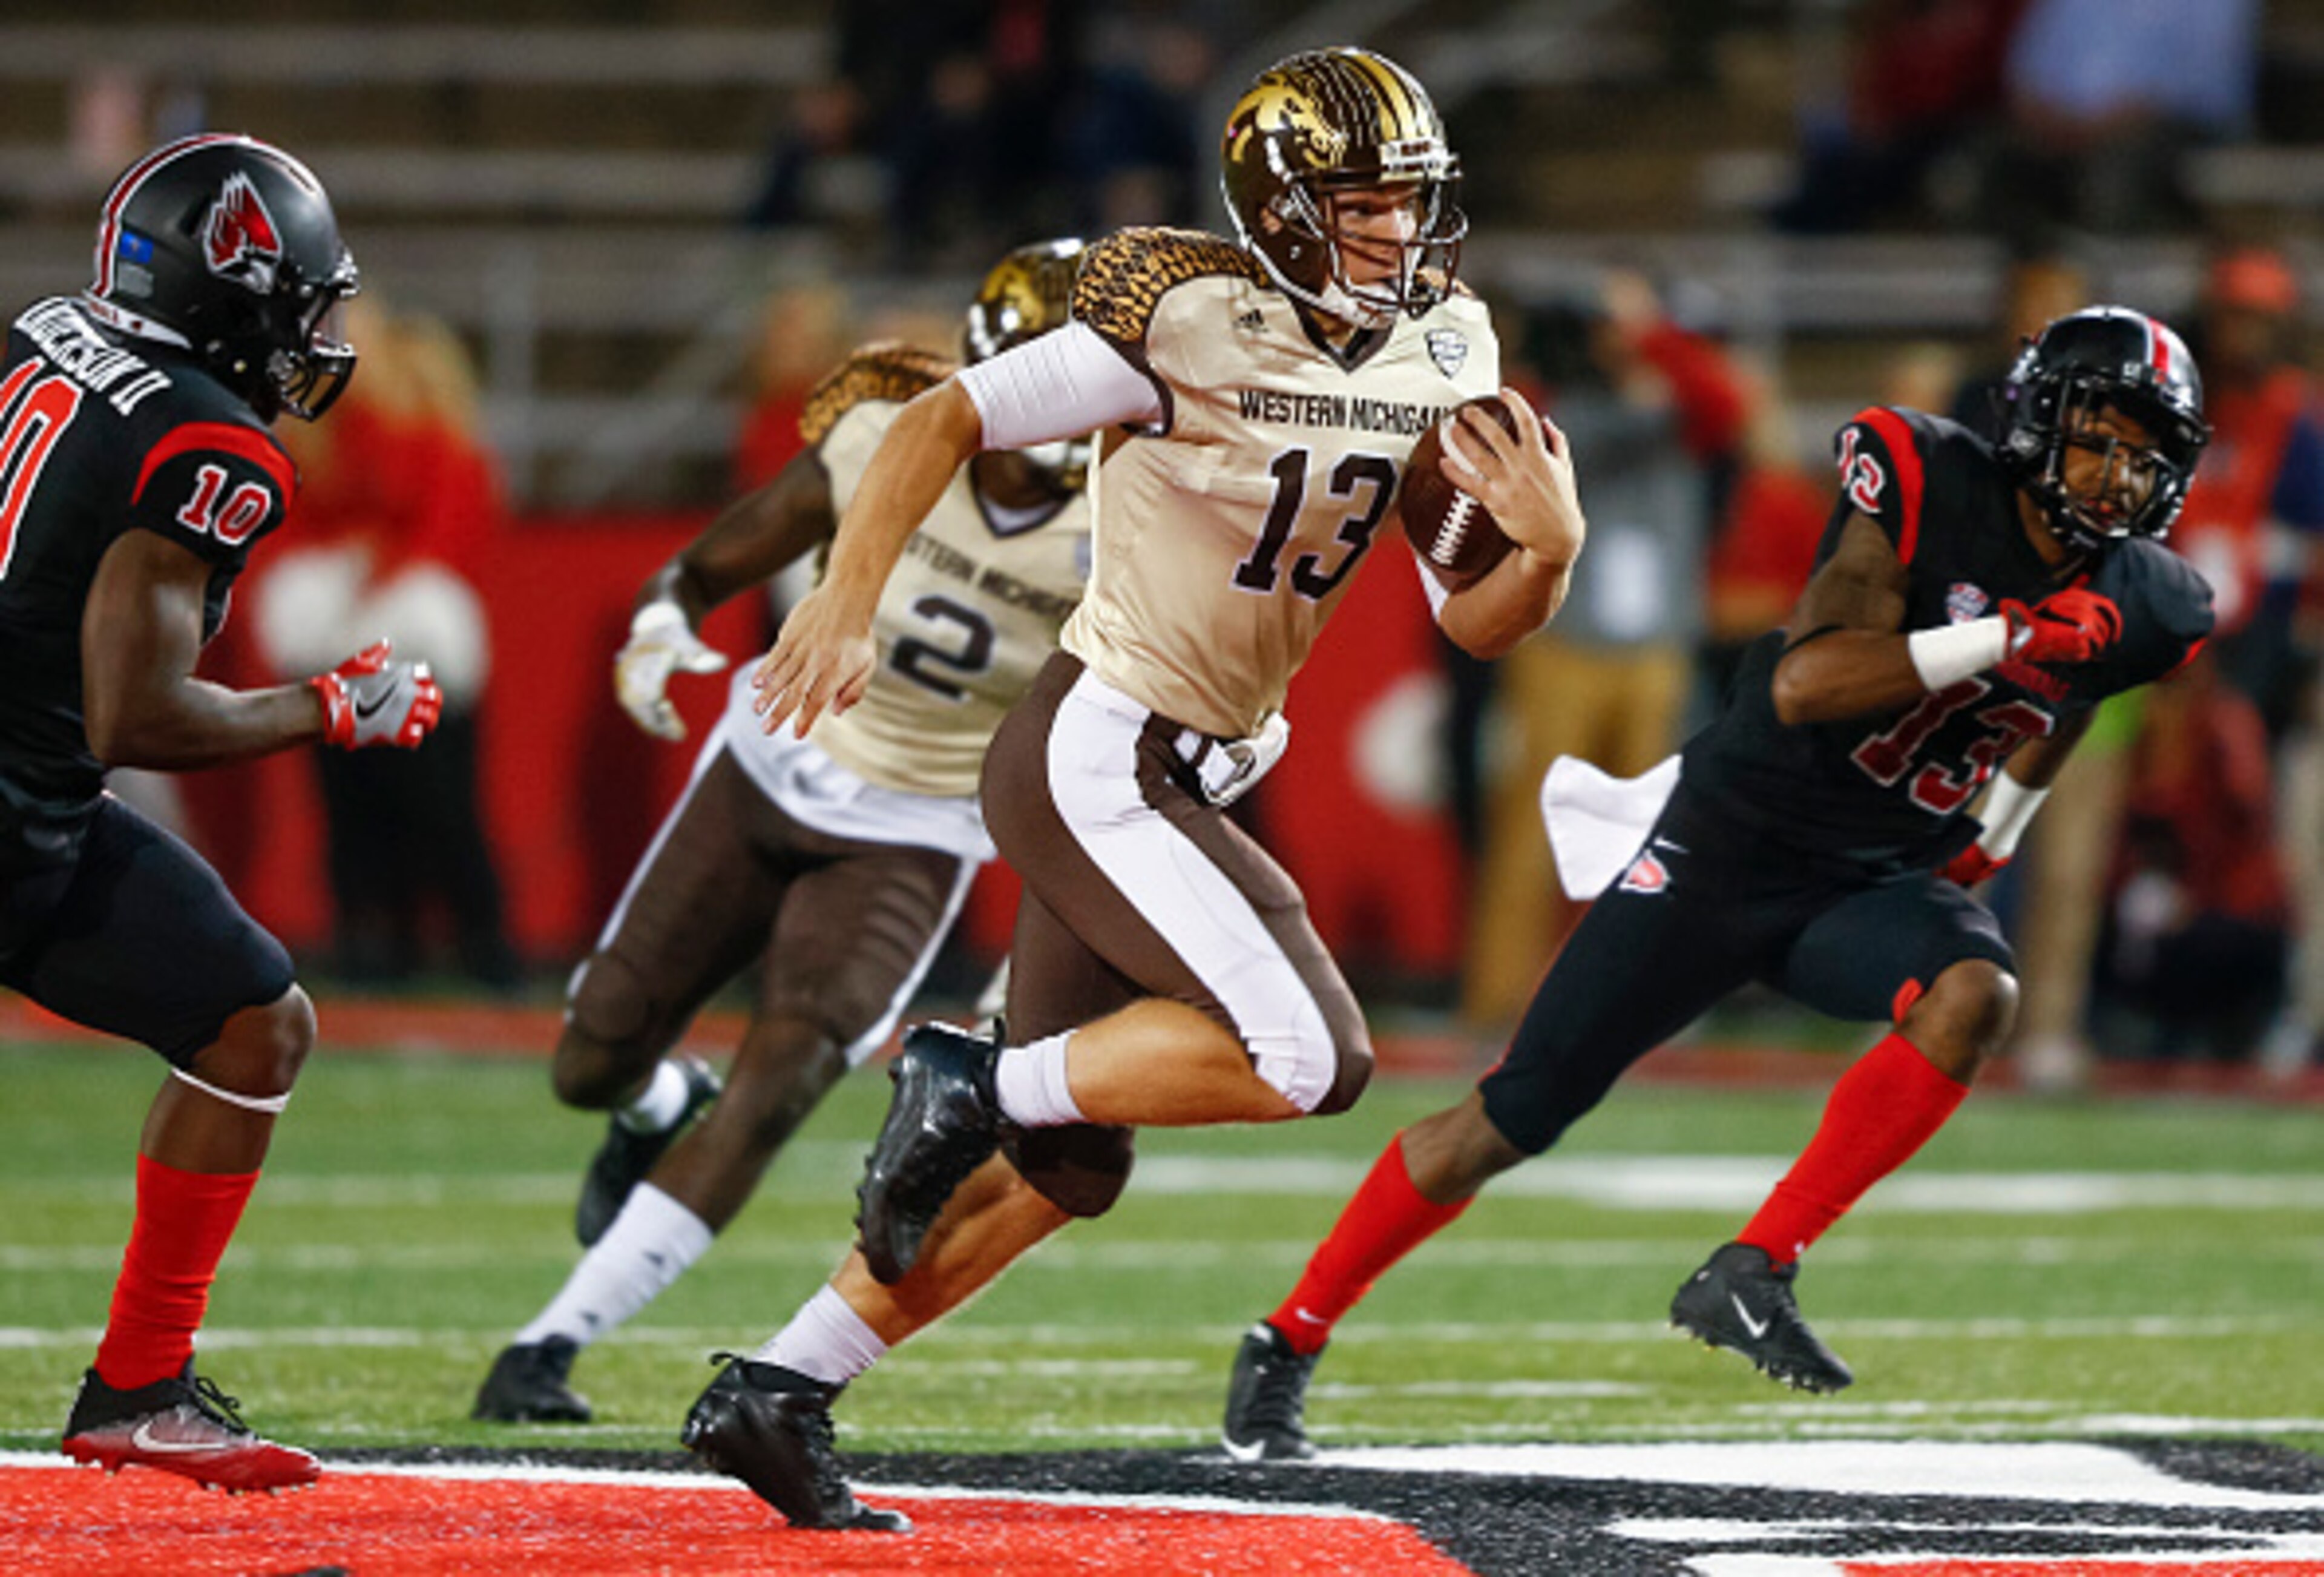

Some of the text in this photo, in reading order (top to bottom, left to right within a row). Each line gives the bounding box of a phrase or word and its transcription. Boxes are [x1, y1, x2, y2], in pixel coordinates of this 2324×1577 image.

[1239, 389, 1347, 427] WESTERN
[177, 464, 272, 546] 10
[1231, 447, 1398, 601] 13
[887, 592, 996, 702] 2
[1850, 676, 2055, 815] 13
